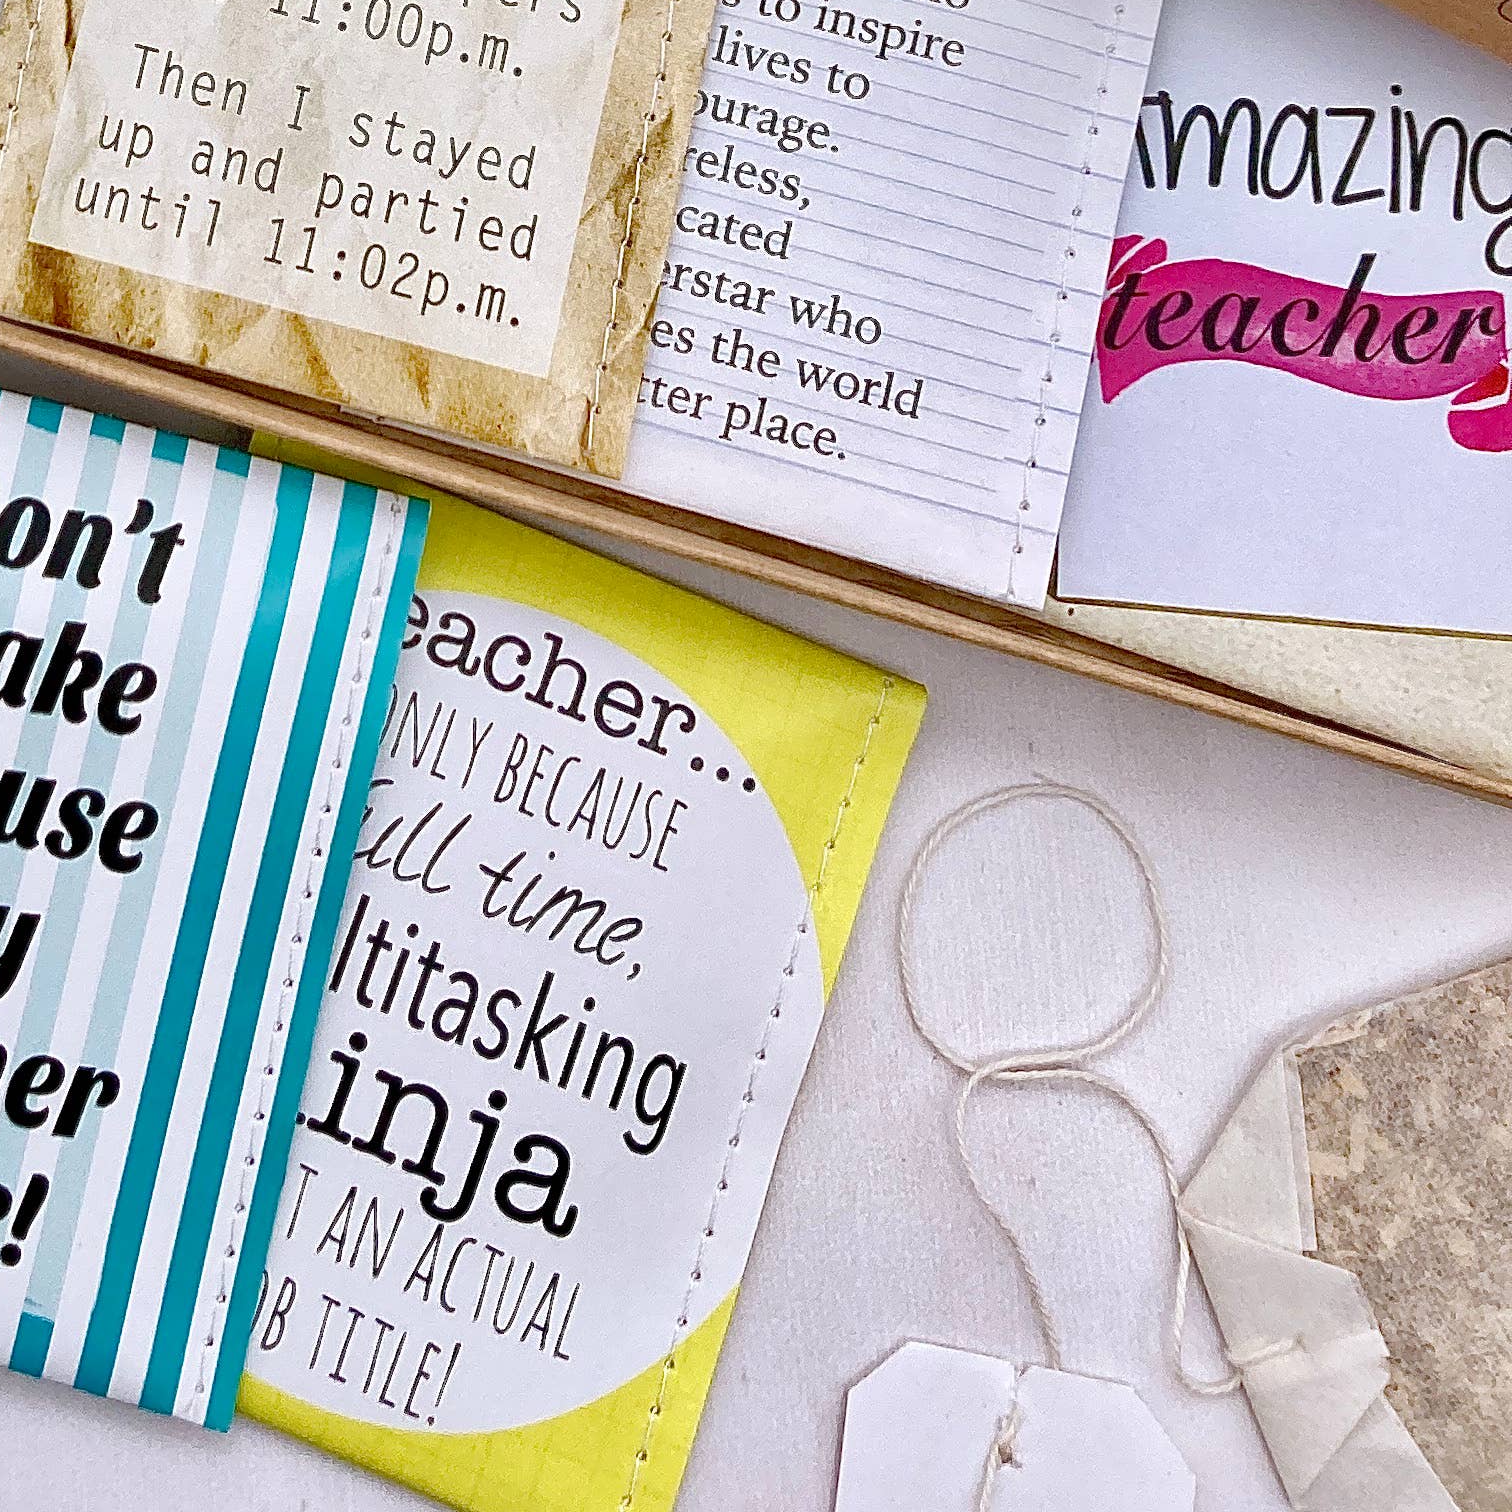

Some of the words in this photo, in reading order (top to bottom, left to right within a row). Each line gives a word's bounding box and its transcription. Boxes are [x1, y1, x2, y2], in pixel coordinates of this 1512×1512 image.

[133, 43, 248, 116] Then
[287, 84, 312, 131] I
[348, 110, 537, 190] stayed
[711, 24, 813, 85] lives
[827, 62, 871, 100] to
[74, 176, 220, 247] until
[262, 218, 521, 328] 11:02p.m.
[97, 113, 155, 167] up
[191, 139, 284, 194] and
[315, 170, 539, 262] partied
[711, 328, 781, 378] the
[795, 358, 925, 419] world
[789, 294, 883, 345] who
[1103, 252, 1505, 366] teacher
[718, 398, 847, 460] place.
[493, 732, 689, 873] BECAUSE
[478, 850, 644, 981] time,
[295, 1030, 580, 1239] inja
[316, 1186, 405, 1280] AN
[404, 1223, 582, 1362] ACTUAL
[309, 1294, 463, 1428] TITLE!
